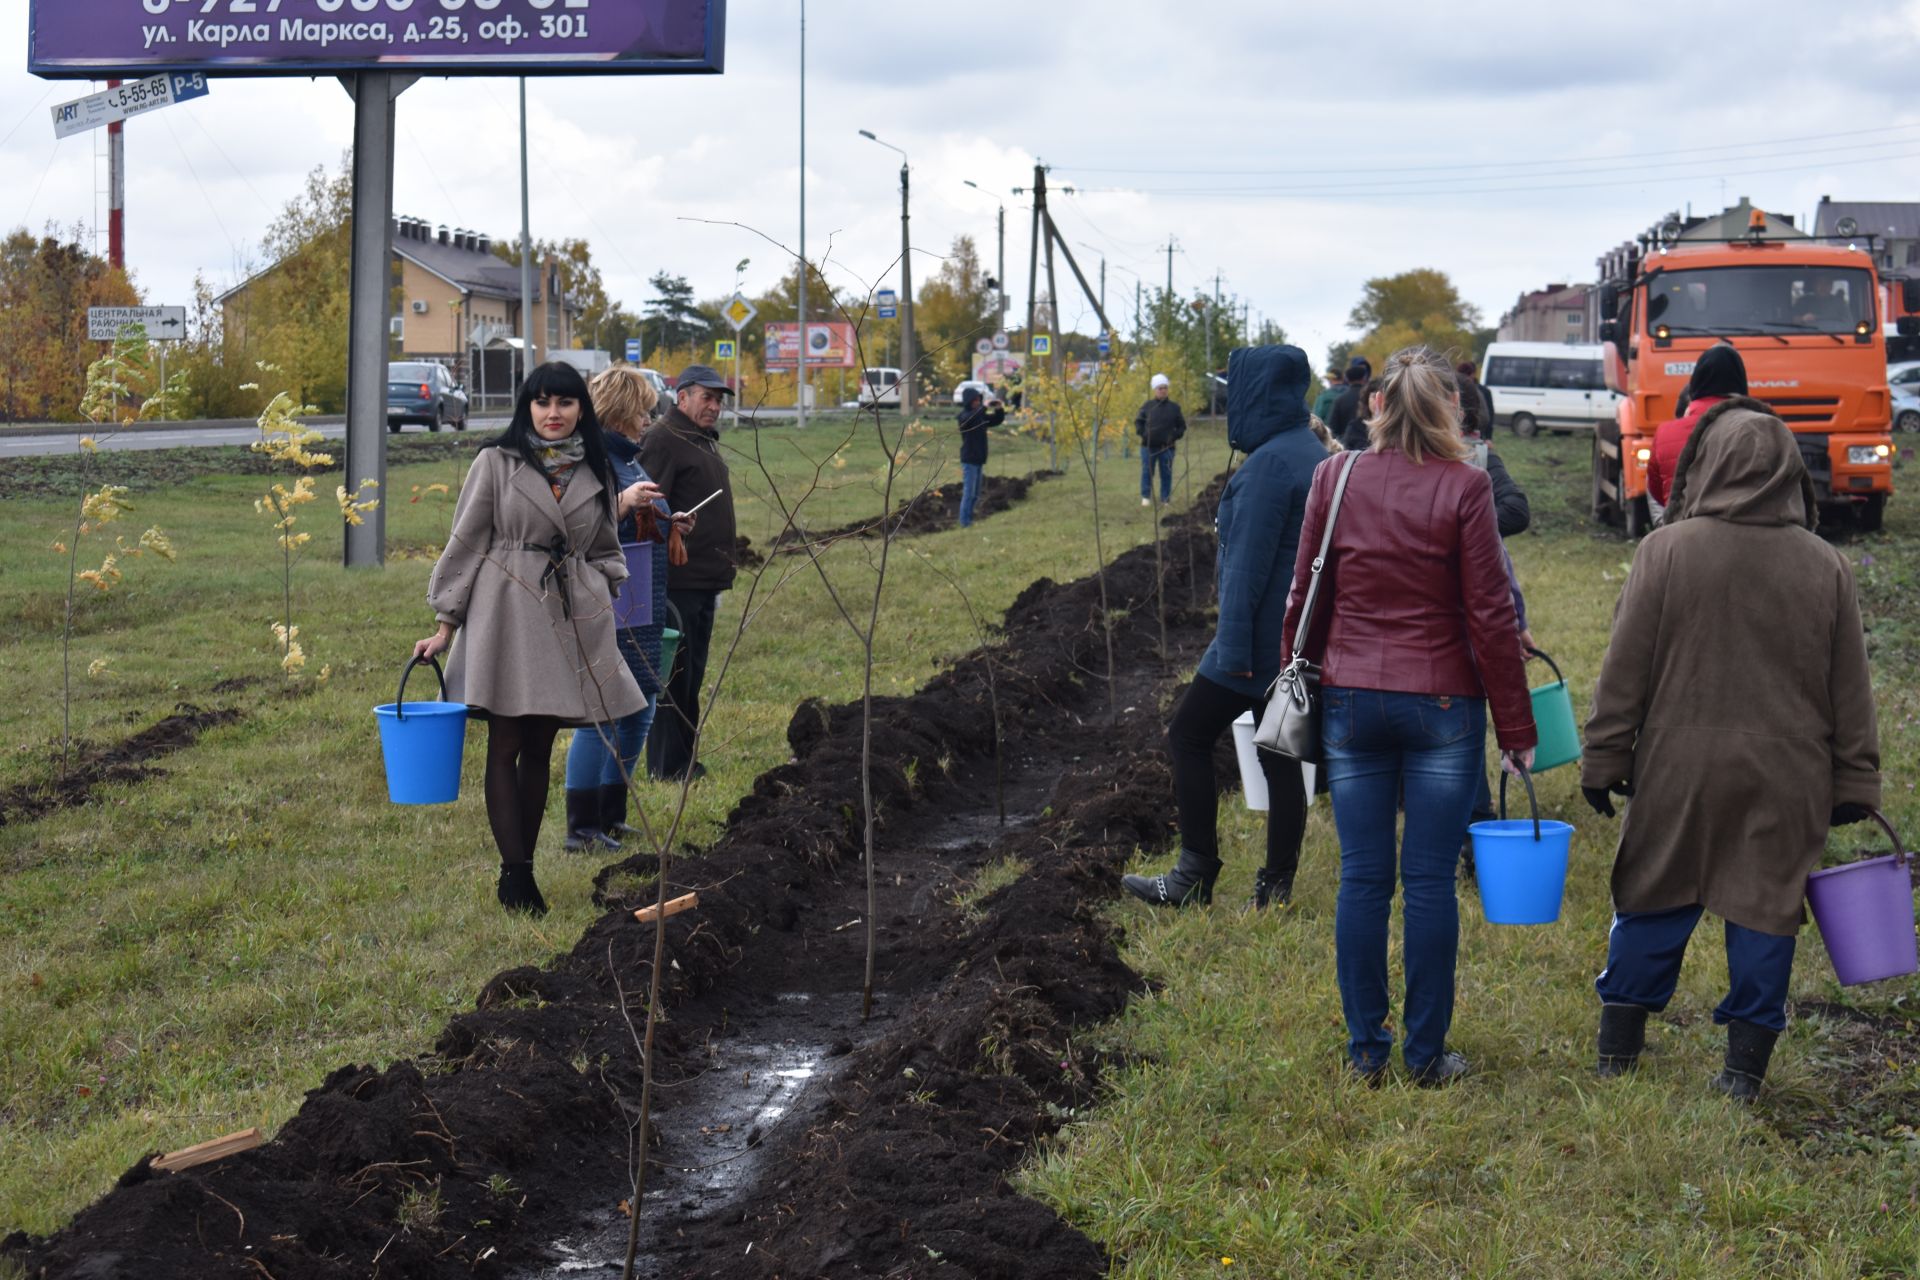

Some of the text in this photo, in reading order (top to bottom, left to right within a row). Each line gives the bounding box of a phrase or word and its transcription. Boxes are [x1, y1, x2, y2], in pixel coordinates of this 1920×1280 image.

[142, 14, 588, 49] ул. Карла Маркса, д.25, оф. 301
[119, 78, 167, 106] 5-55-65
[56, 103, 80, 124] ART
[91, 309, 162, 318] ЦЕНТРАЛЬНАЯ
